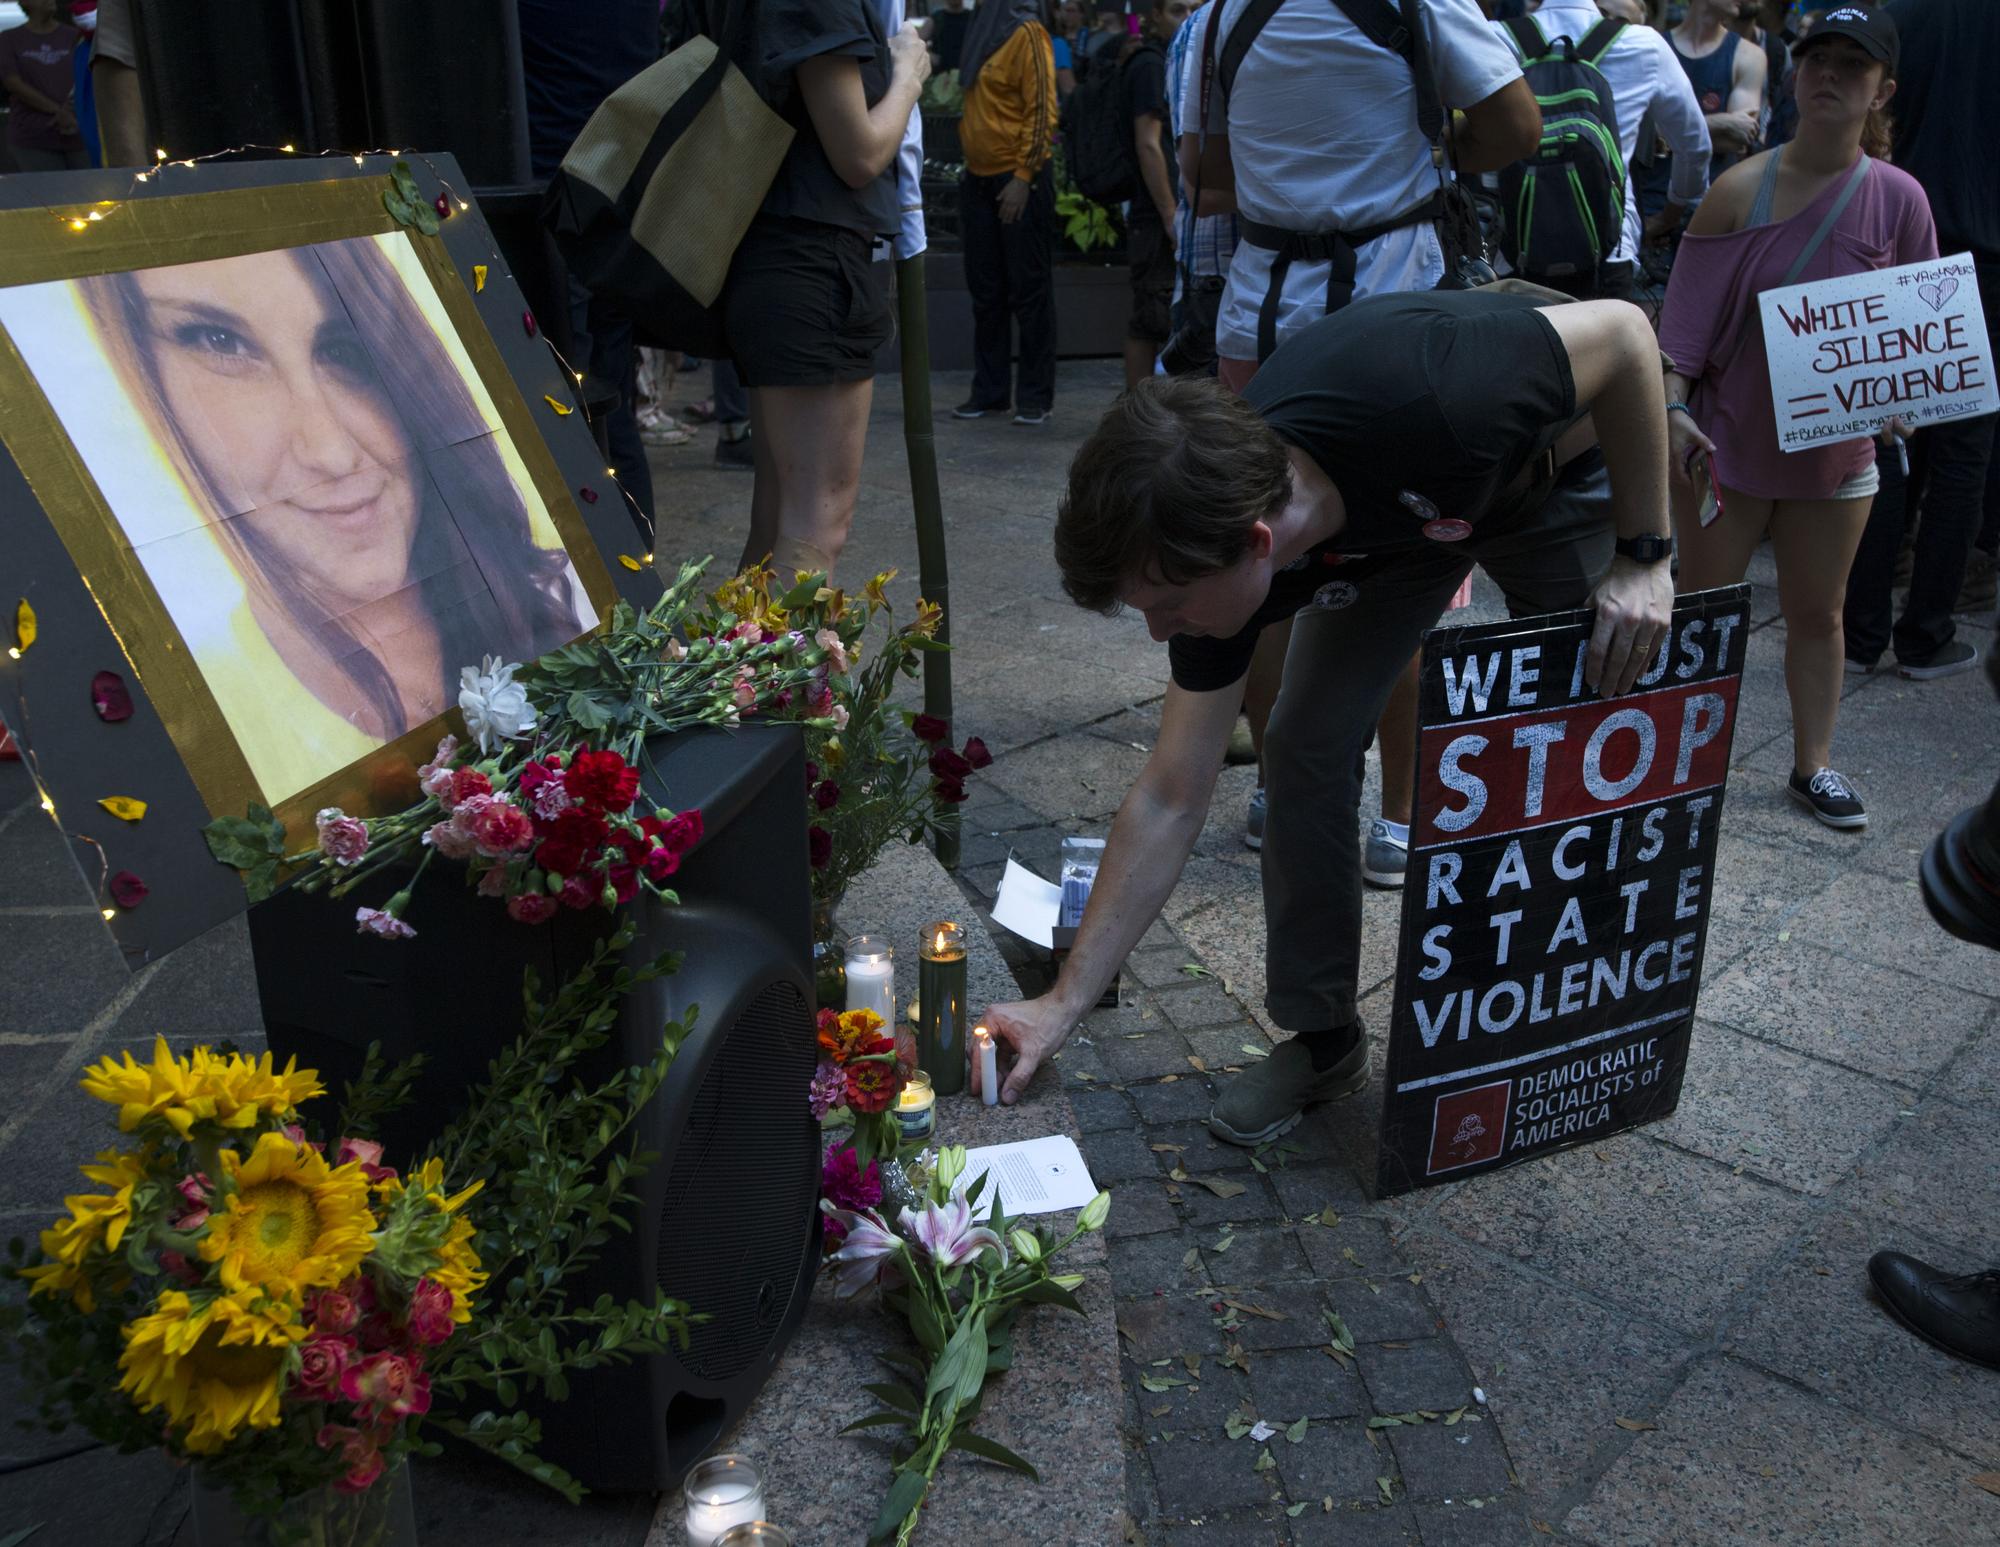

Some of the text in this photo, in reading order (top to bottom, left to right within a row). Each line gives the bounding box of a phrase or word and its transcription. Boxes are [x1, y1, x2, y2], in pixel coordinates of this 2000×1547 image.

[1777, 294, 1889, 337] WHITE
[1812, 314, 1969, 373] SILENCE
[1833, 355, 1985, 413] VIOLENCE
[1783, 411, 1919, 443] #BLACKLIVESMAER
[1441, 613, 1742, 717] WE UST
[1432, 692, 1727, 833] STOP
[1426, 796, 1713, 910] RACIST
[1418, 865, 1702, 981] STATE
[1412, 931, 1697, 1049] VIOLENCE
[1515, 1060, 1664, 1126] SOCIALISTS of
[1518, 1037, 1659, 1099] DEMOCRATIC
[1510, 1103, 1611, 1151] AMERICA
